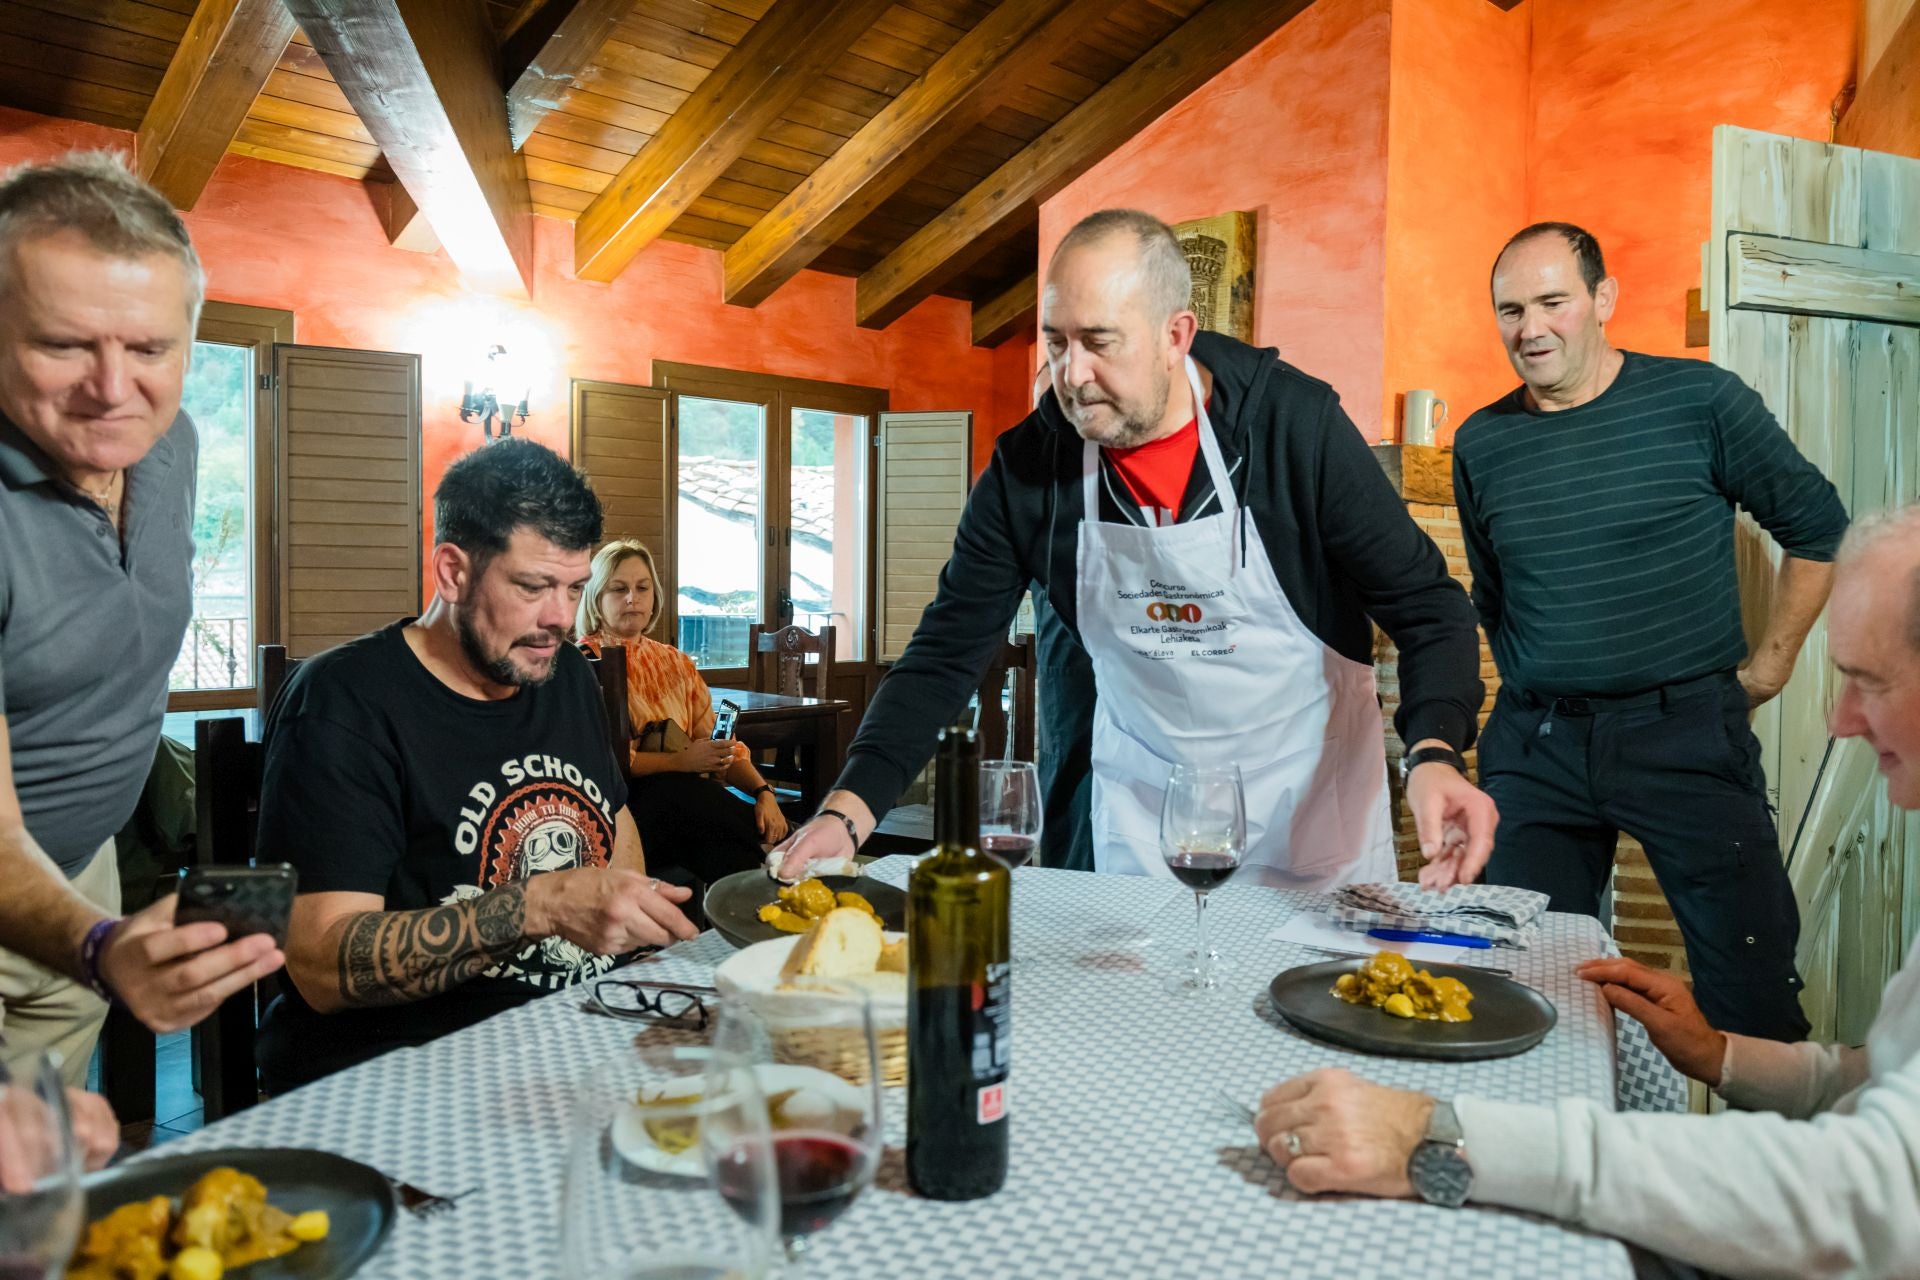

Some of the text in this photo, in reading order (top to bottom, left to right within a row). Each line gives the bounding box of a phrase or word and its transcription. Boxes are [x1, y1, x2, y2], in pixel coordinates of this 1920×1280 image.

[1150, 579, 1186, 591] Concurso
[1130, 625, 1160, 635] Elkarte
[1191, 647, 1235, 657] EL CORREO
[455, 754, 614, 855] OLD SCHOOL
[540, 803, 556, 816] TO
